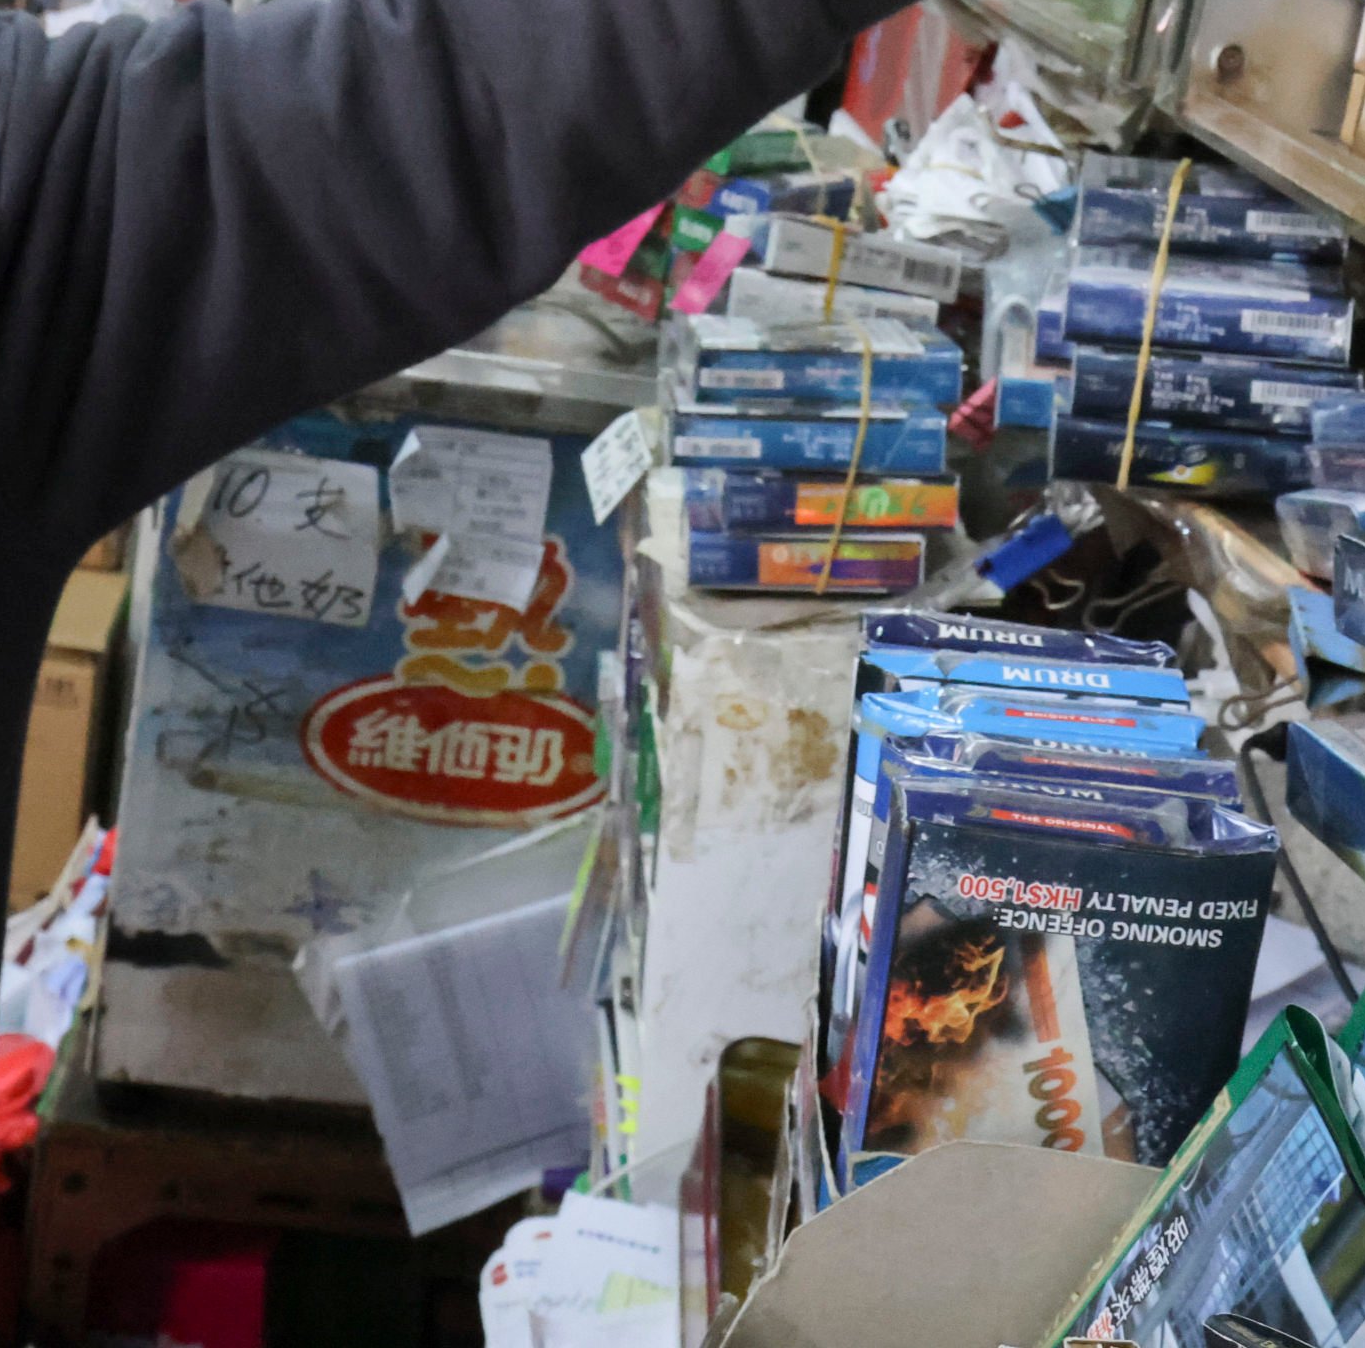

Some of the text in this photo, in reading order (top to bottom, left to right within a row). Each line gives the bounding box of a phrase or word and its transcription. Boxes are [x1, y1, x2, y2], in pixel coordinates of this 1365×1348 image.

[219, 550, 367, 619] 他奶
[937, 622, 1044, 648] DRUM
[1001, 665, 1112, 690] DRUM
[346, 706, 566, 788] 維他奶
[1011, 812, 1116, 834] THE ORIGINAL
[958, 874, 1258, 920] FIXED PENALTY HK$1,500
[993, 908, 1223, 948] SMOKING OFFENCE:
[1023, 1046, 1087, 1152] 1000
